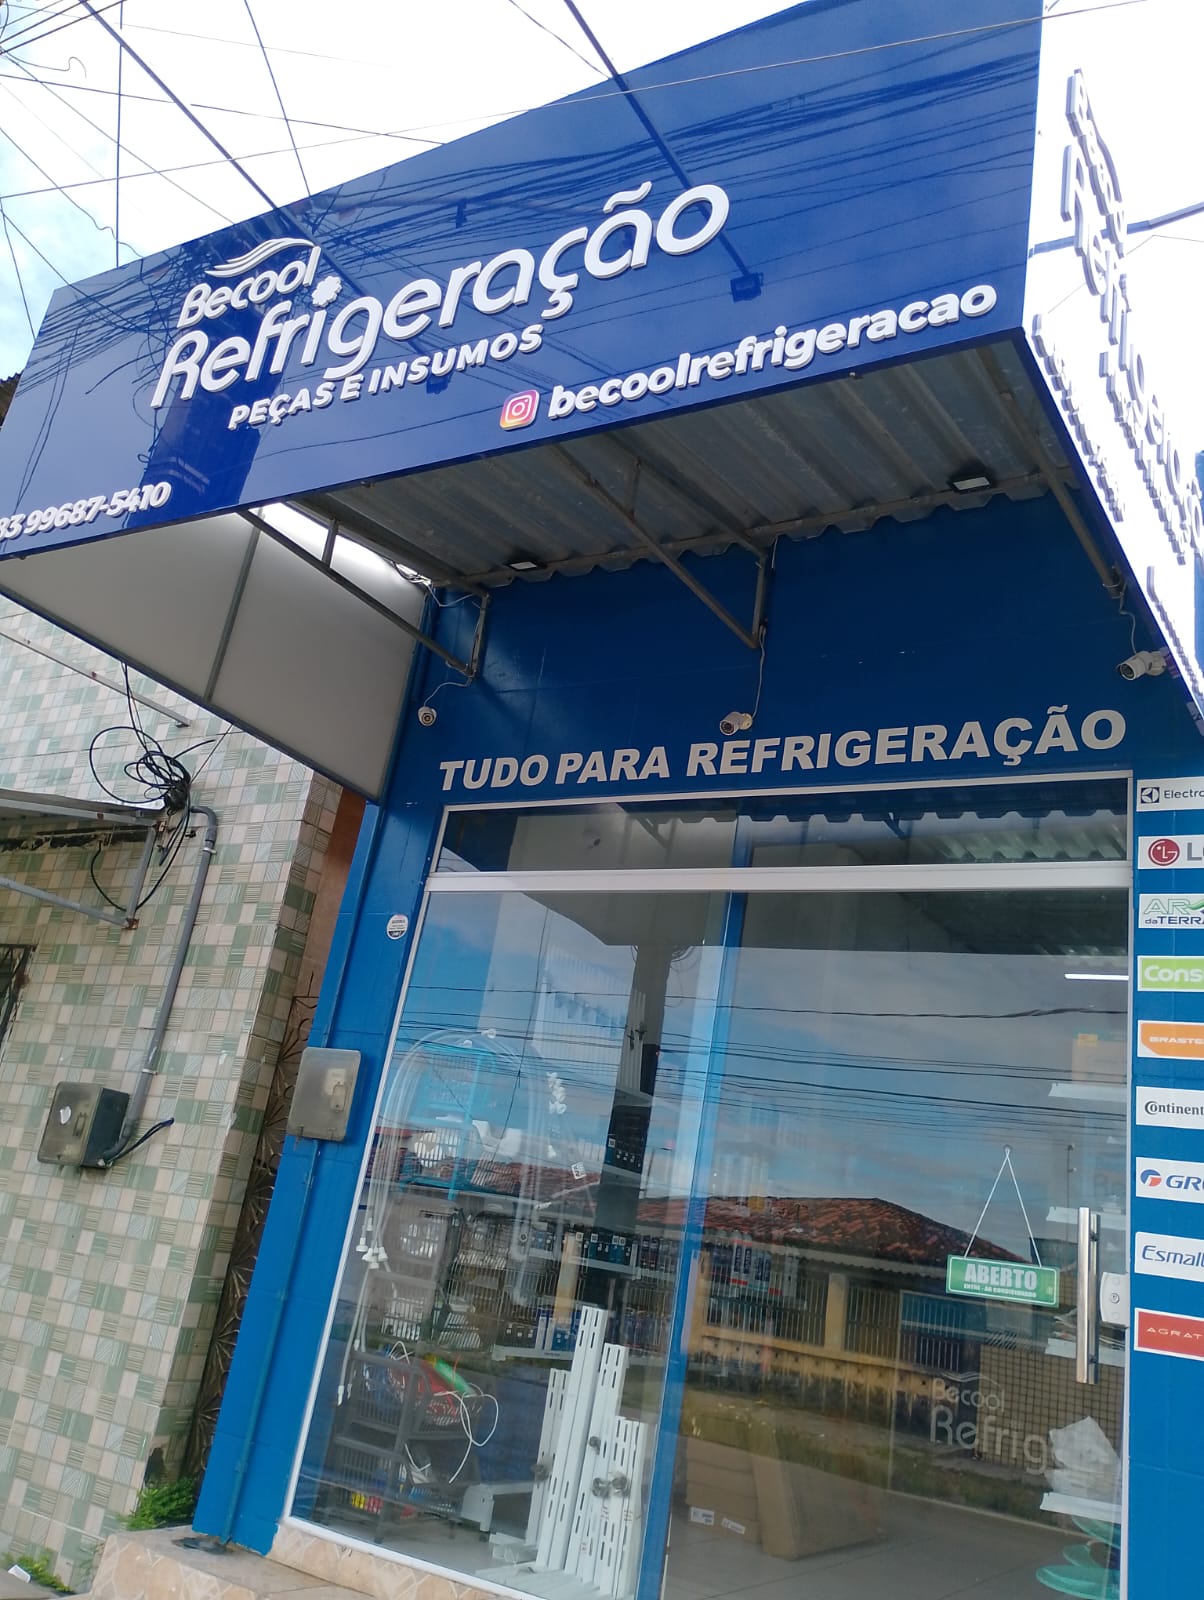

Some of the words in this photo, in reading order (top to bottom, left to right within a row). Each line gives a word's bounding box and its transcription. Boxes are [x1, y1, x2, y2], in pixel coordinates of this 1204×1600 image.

[150, 181, 730, 409] Refrigeração
[176, 246, 321, 329] Becool
[227, 382, 336, 431] PEÇAS
[339, 373, 365, 403] E
[368, 324, 544, 395] INSUMOS
[548, 284, 997, 420] becoolrefrigeracao
[24, 481, 172, 536] 99687-5410
[439, 754, 549, 791] TUDO
[555, 746, 670, 785] PARA
[686, 704, 1127, 777] REFRIGERAÇÃO
[964, 1263, 1038, 1291] ABERTO
[932, 1378, 1005, 1413] Becool
[930, 1405, 1049, 1475] Refrig
